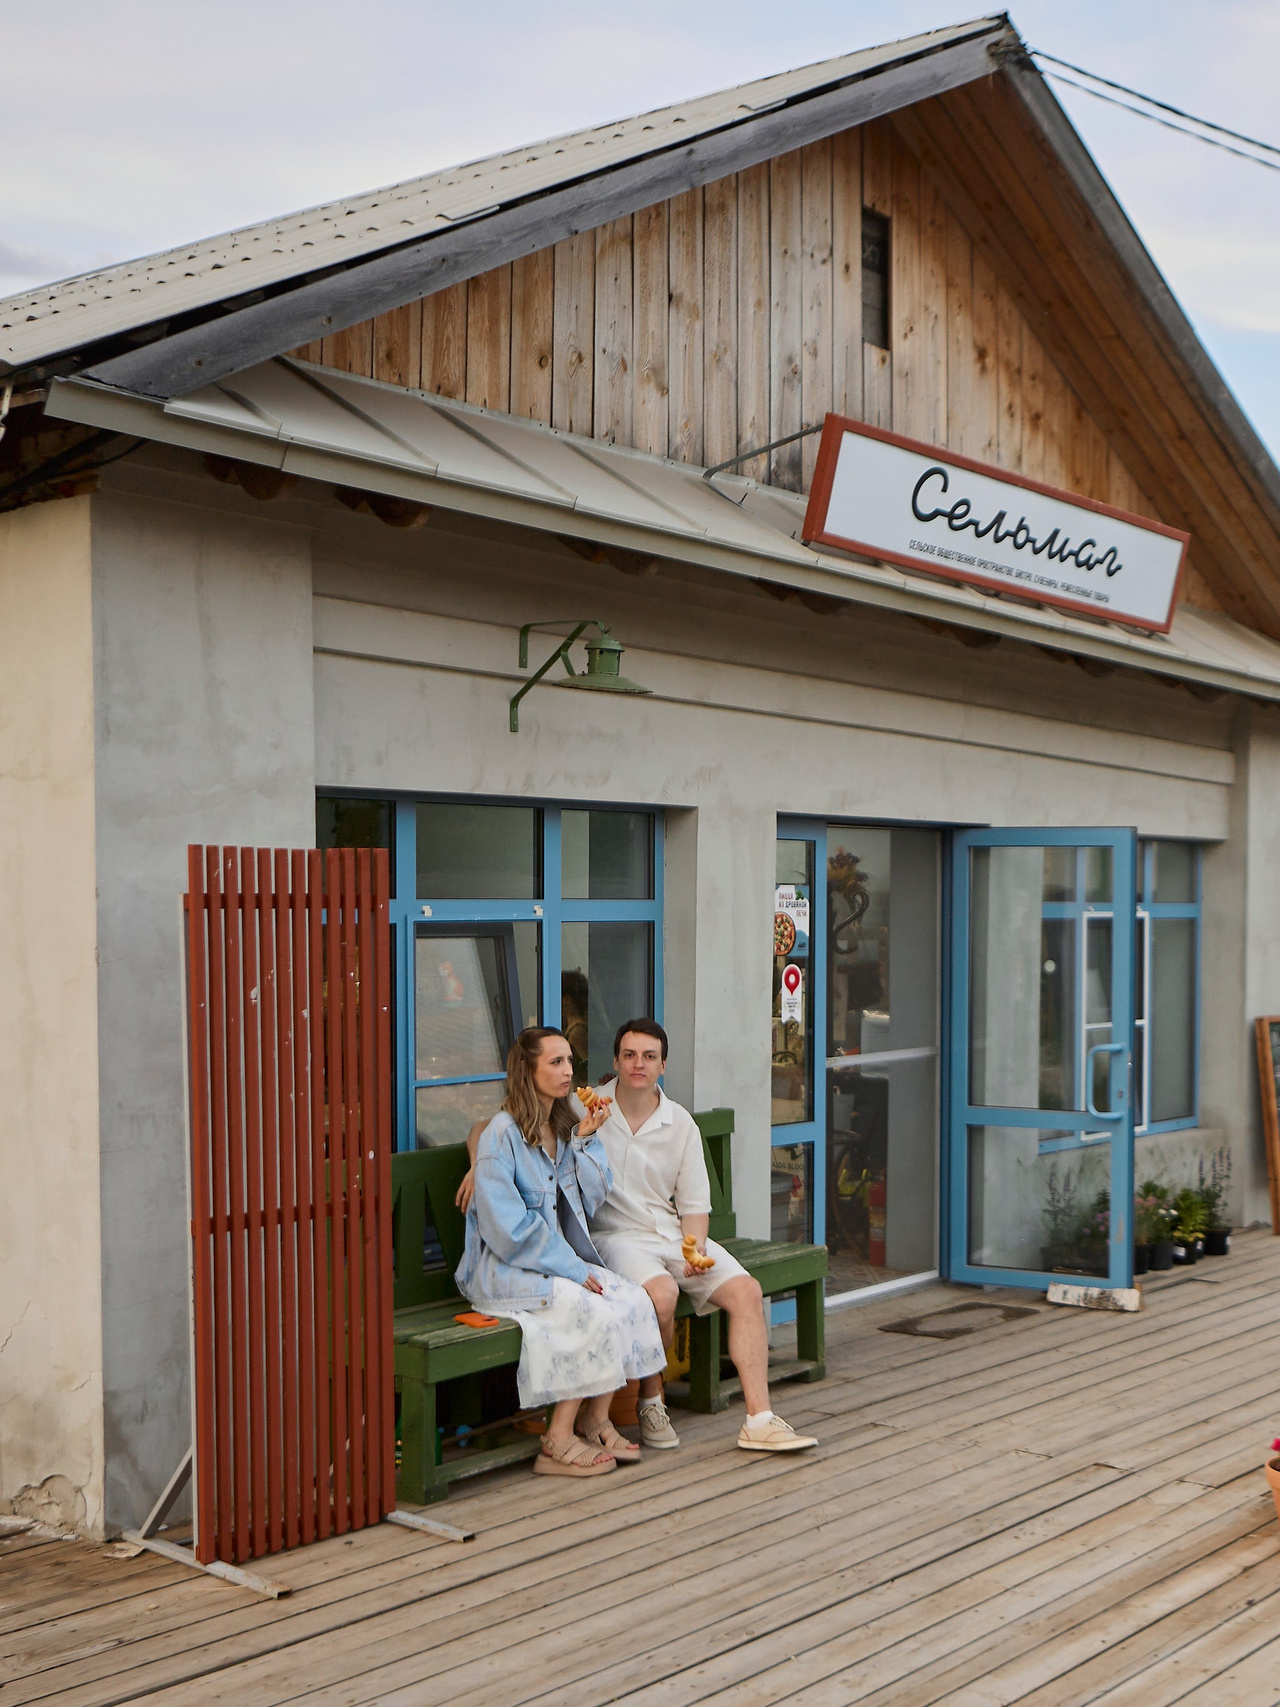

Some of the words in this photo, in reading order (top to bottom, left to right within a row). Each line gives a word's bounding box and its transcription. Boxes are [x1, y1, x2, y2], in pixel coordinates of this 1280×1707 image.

[911, 466, 1123, 577] Сельмаг
[909, 539, 936, 555] СЕЛЬСКОЕ
[937, 547, 977, 566] ОБЩЕСТВЕННОЕ
[779, 892, 793, 900] ПИЦЦА
[785, 900, 807, 908] ДРОВЯНОЙ
[796, 909, 807, 917] ПЕЧИ
